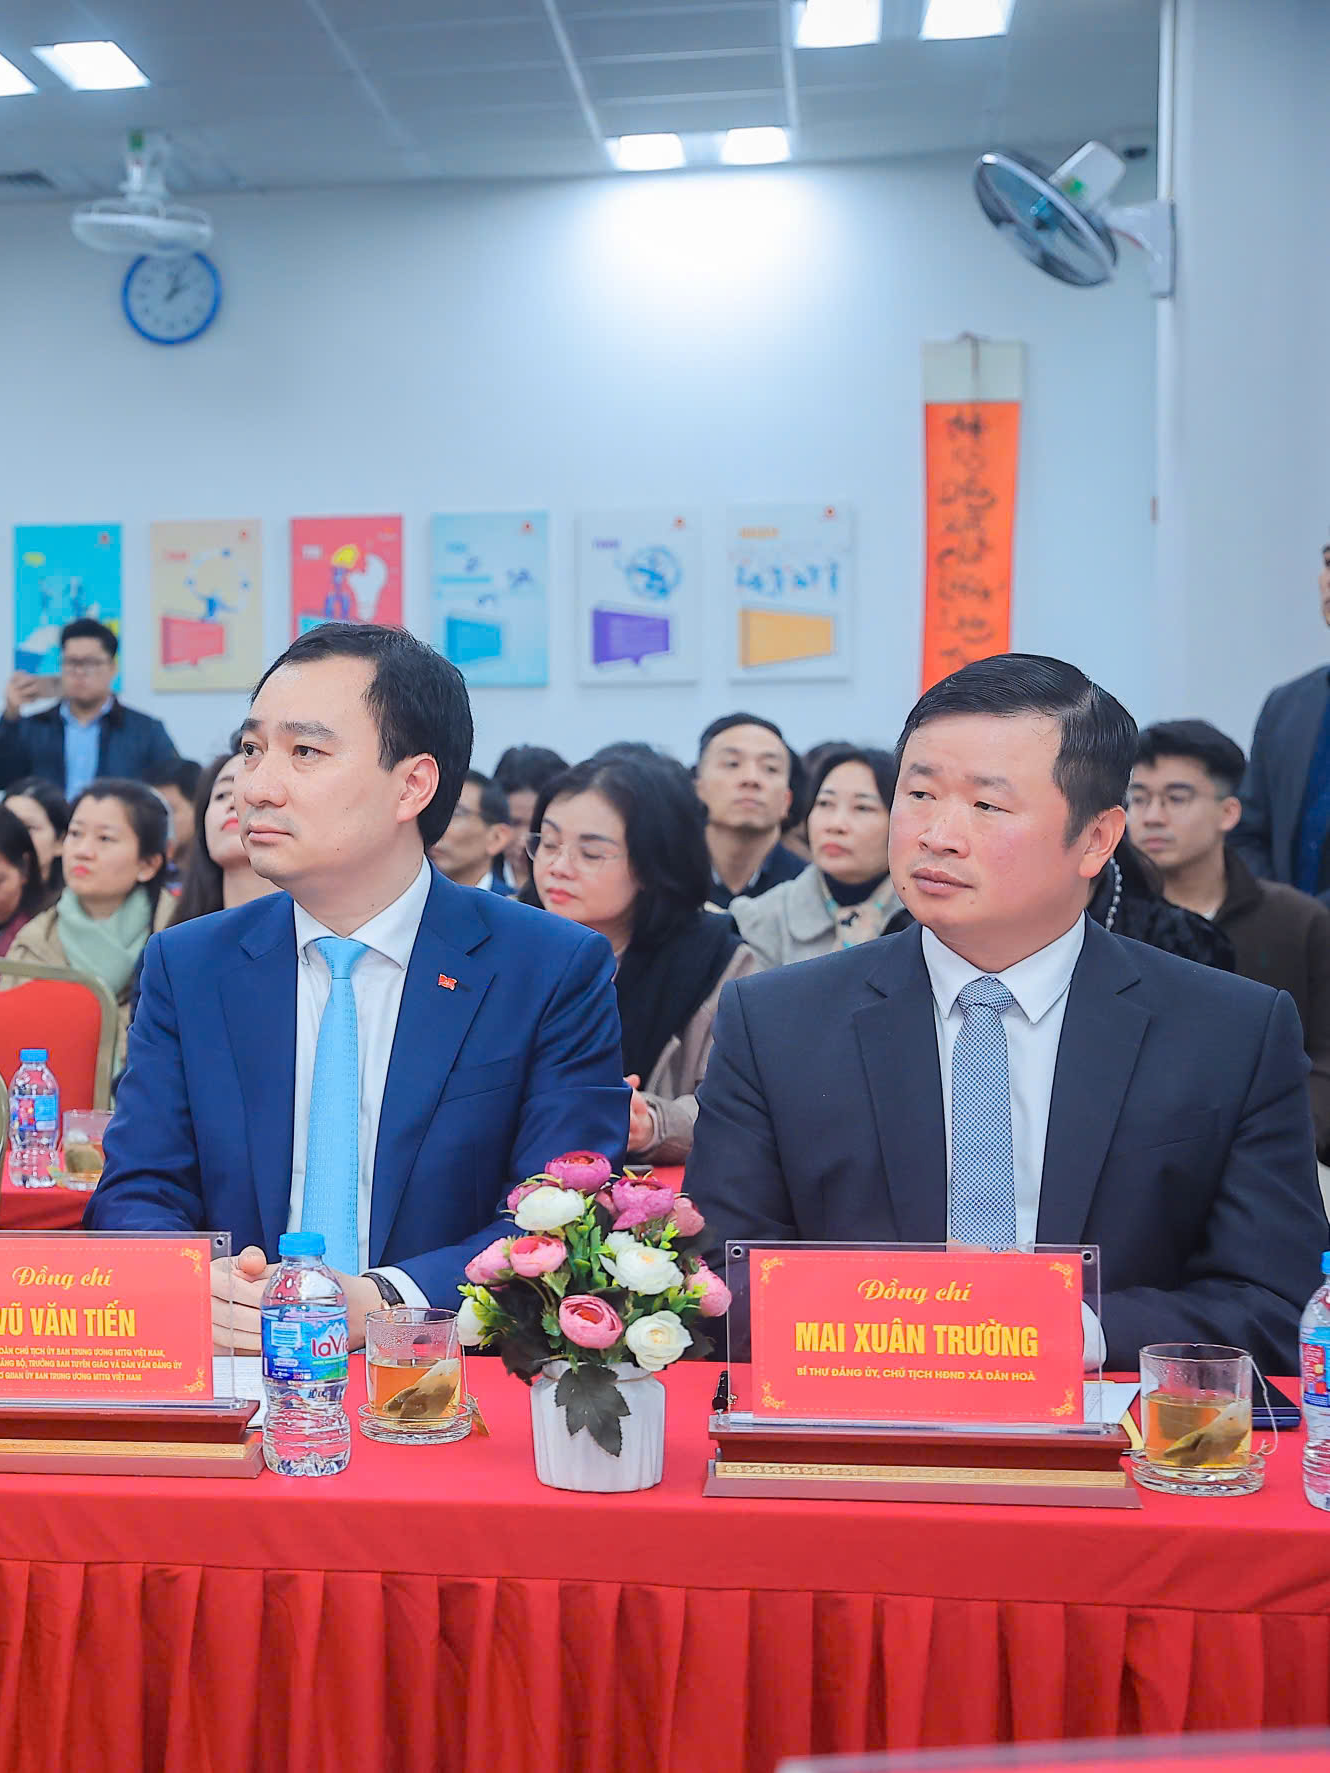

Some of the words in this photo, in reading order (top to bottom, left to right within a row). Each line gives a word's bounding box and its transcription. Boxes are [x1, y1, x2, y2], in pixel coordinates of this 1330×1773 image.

[12, 1265, 74, 1290] Đồng
[80, 1266, 114, 1287] chí
[857, 1278, 927, 1304] Đồng
[935, 1280, 973, 1301] chí
[30, 1301, 78, 1337] VĂN
[83, 1299, 136, 1337] TIẾN
[795, 1322, 845, 1353] MAI
[854, 1317, 925, 1354] XUÂN
[933, 1318, 1038, 1357] TRƯỜNG
